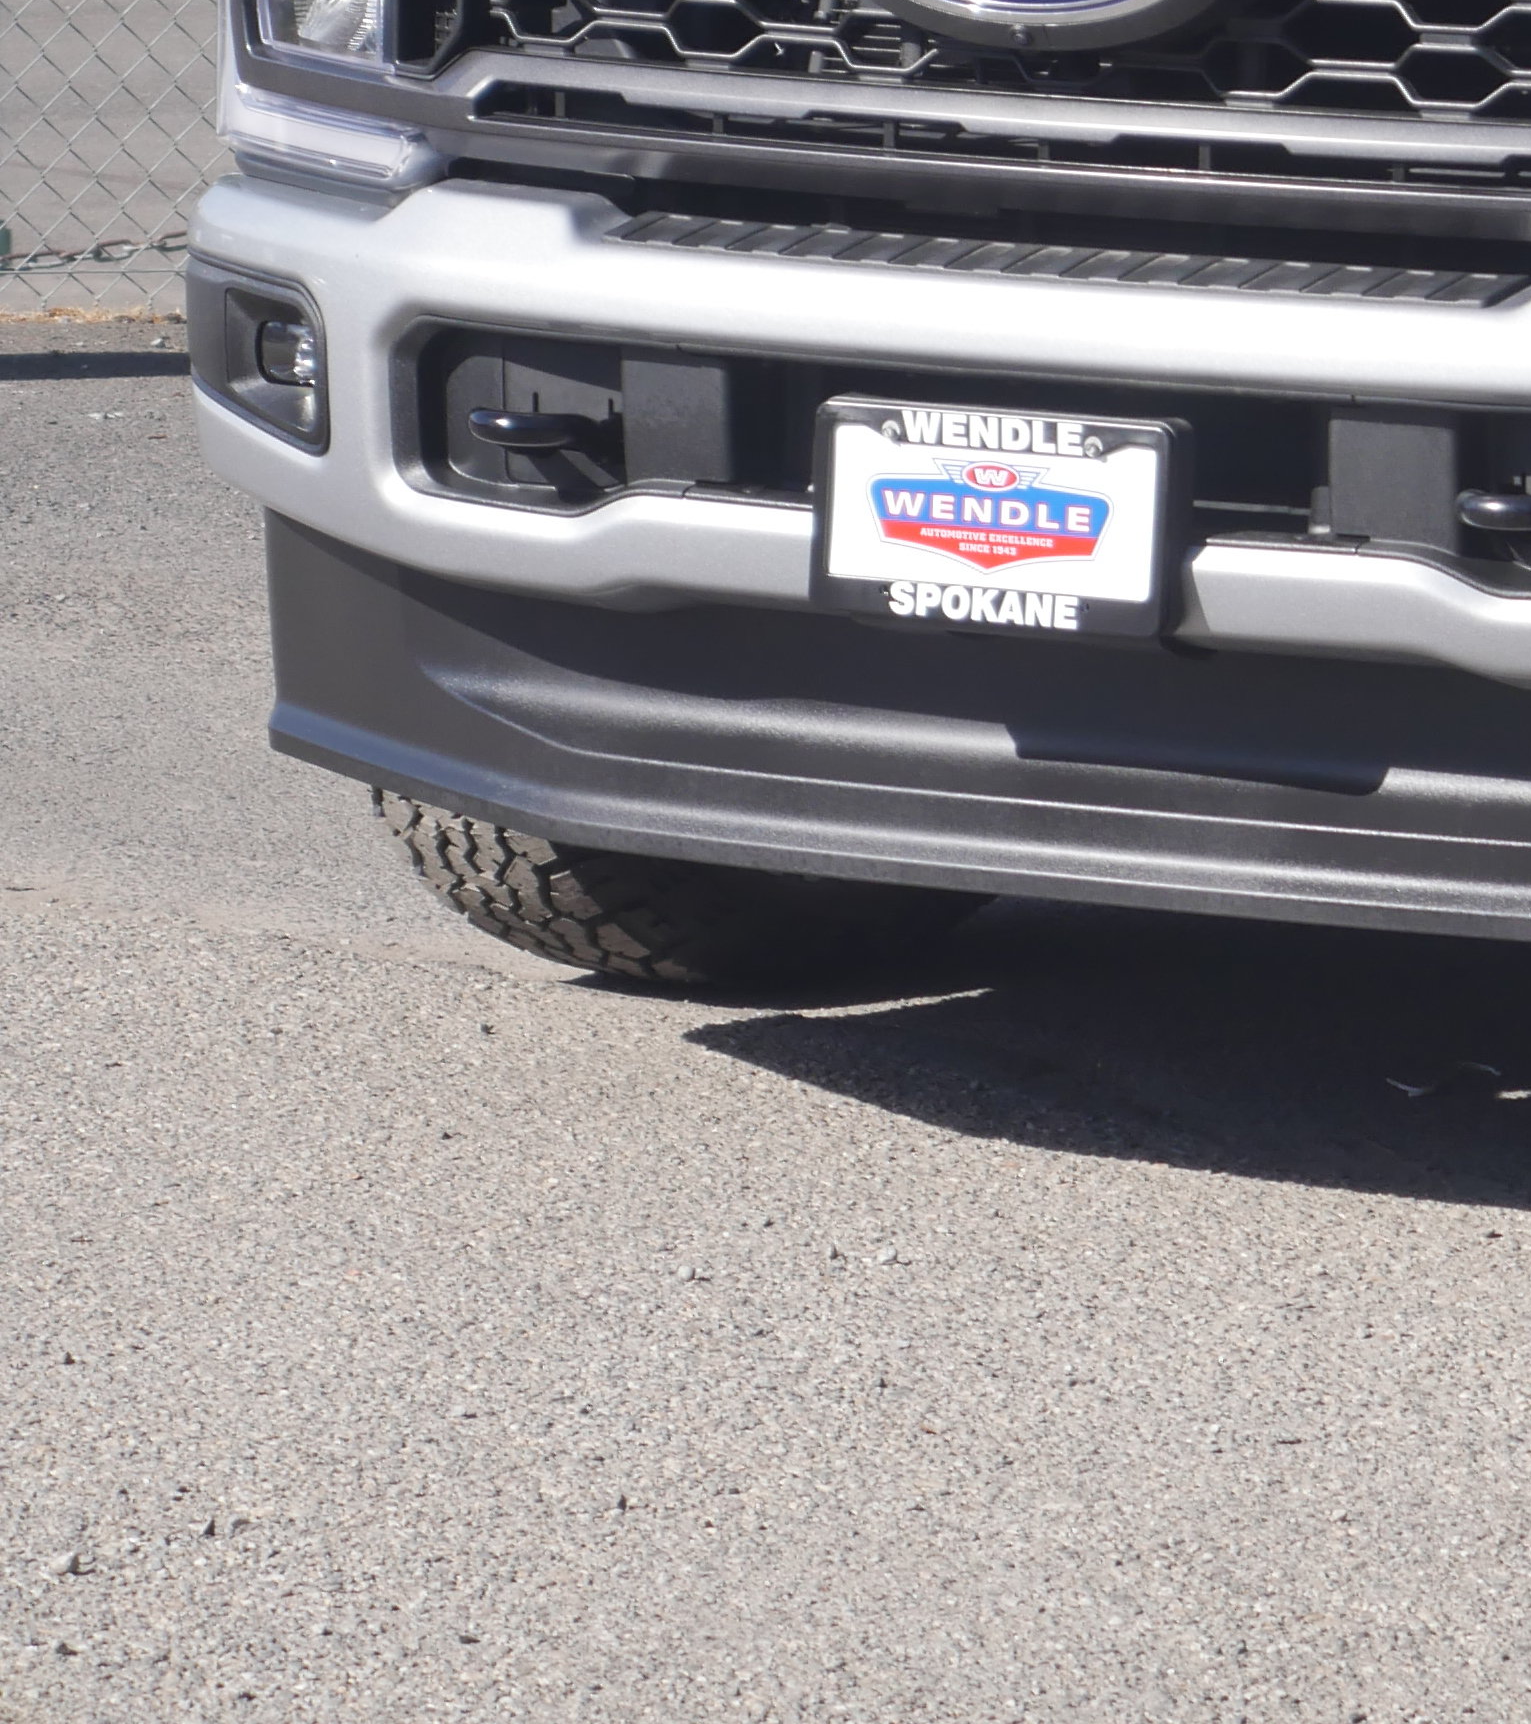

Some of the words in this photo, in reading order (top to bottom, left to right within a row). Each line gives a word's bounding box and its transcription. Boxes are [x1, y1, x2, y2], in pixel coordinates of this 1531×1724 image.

[902, 410, 1084, 456] WENDLE
[882, 489, 1092, 533] WENDLE
[919, 527, 987, 542] AUTOMOTIVE
[988, 533, 1054, 548] EXCELLENCE
[958, 542, 991, 553] SINCE
[992, 545, 1017, 556] 1943
[888, 580, 1079, 630] SPOKANE
